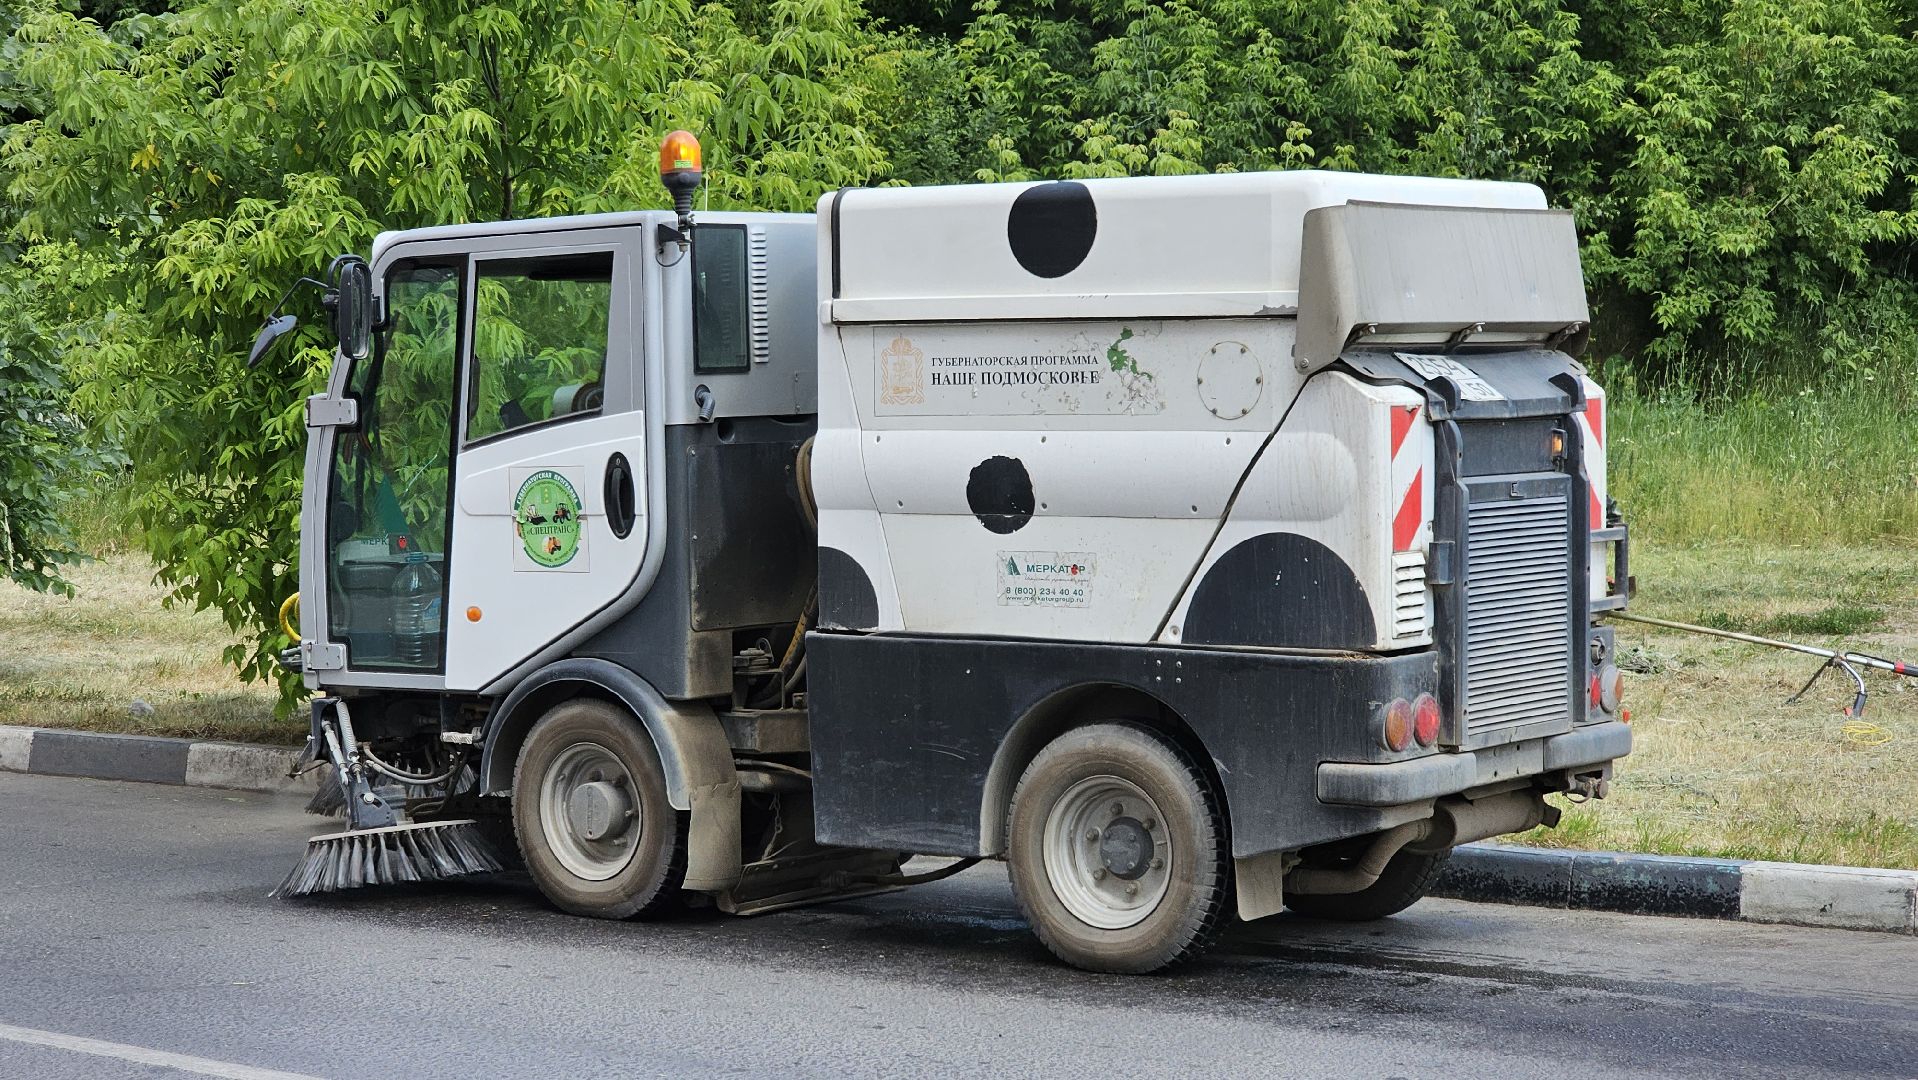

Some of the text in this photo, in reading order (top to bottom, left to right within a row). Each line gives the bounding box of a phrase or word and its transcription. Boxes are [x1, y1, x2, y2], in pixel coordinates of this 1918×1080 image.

[931, 355, 1099, 367] ГУБЕРНАТОРСКАЯ ПРОГРАММА
[931, 371, 1100, 387] НАШЕ ПОДМОСКОВЬЕ
[1014, 587, 1037, 596] (800)
[1060, 588, 1070, 596] 40
[1073, 589, 1084, 597] 40
